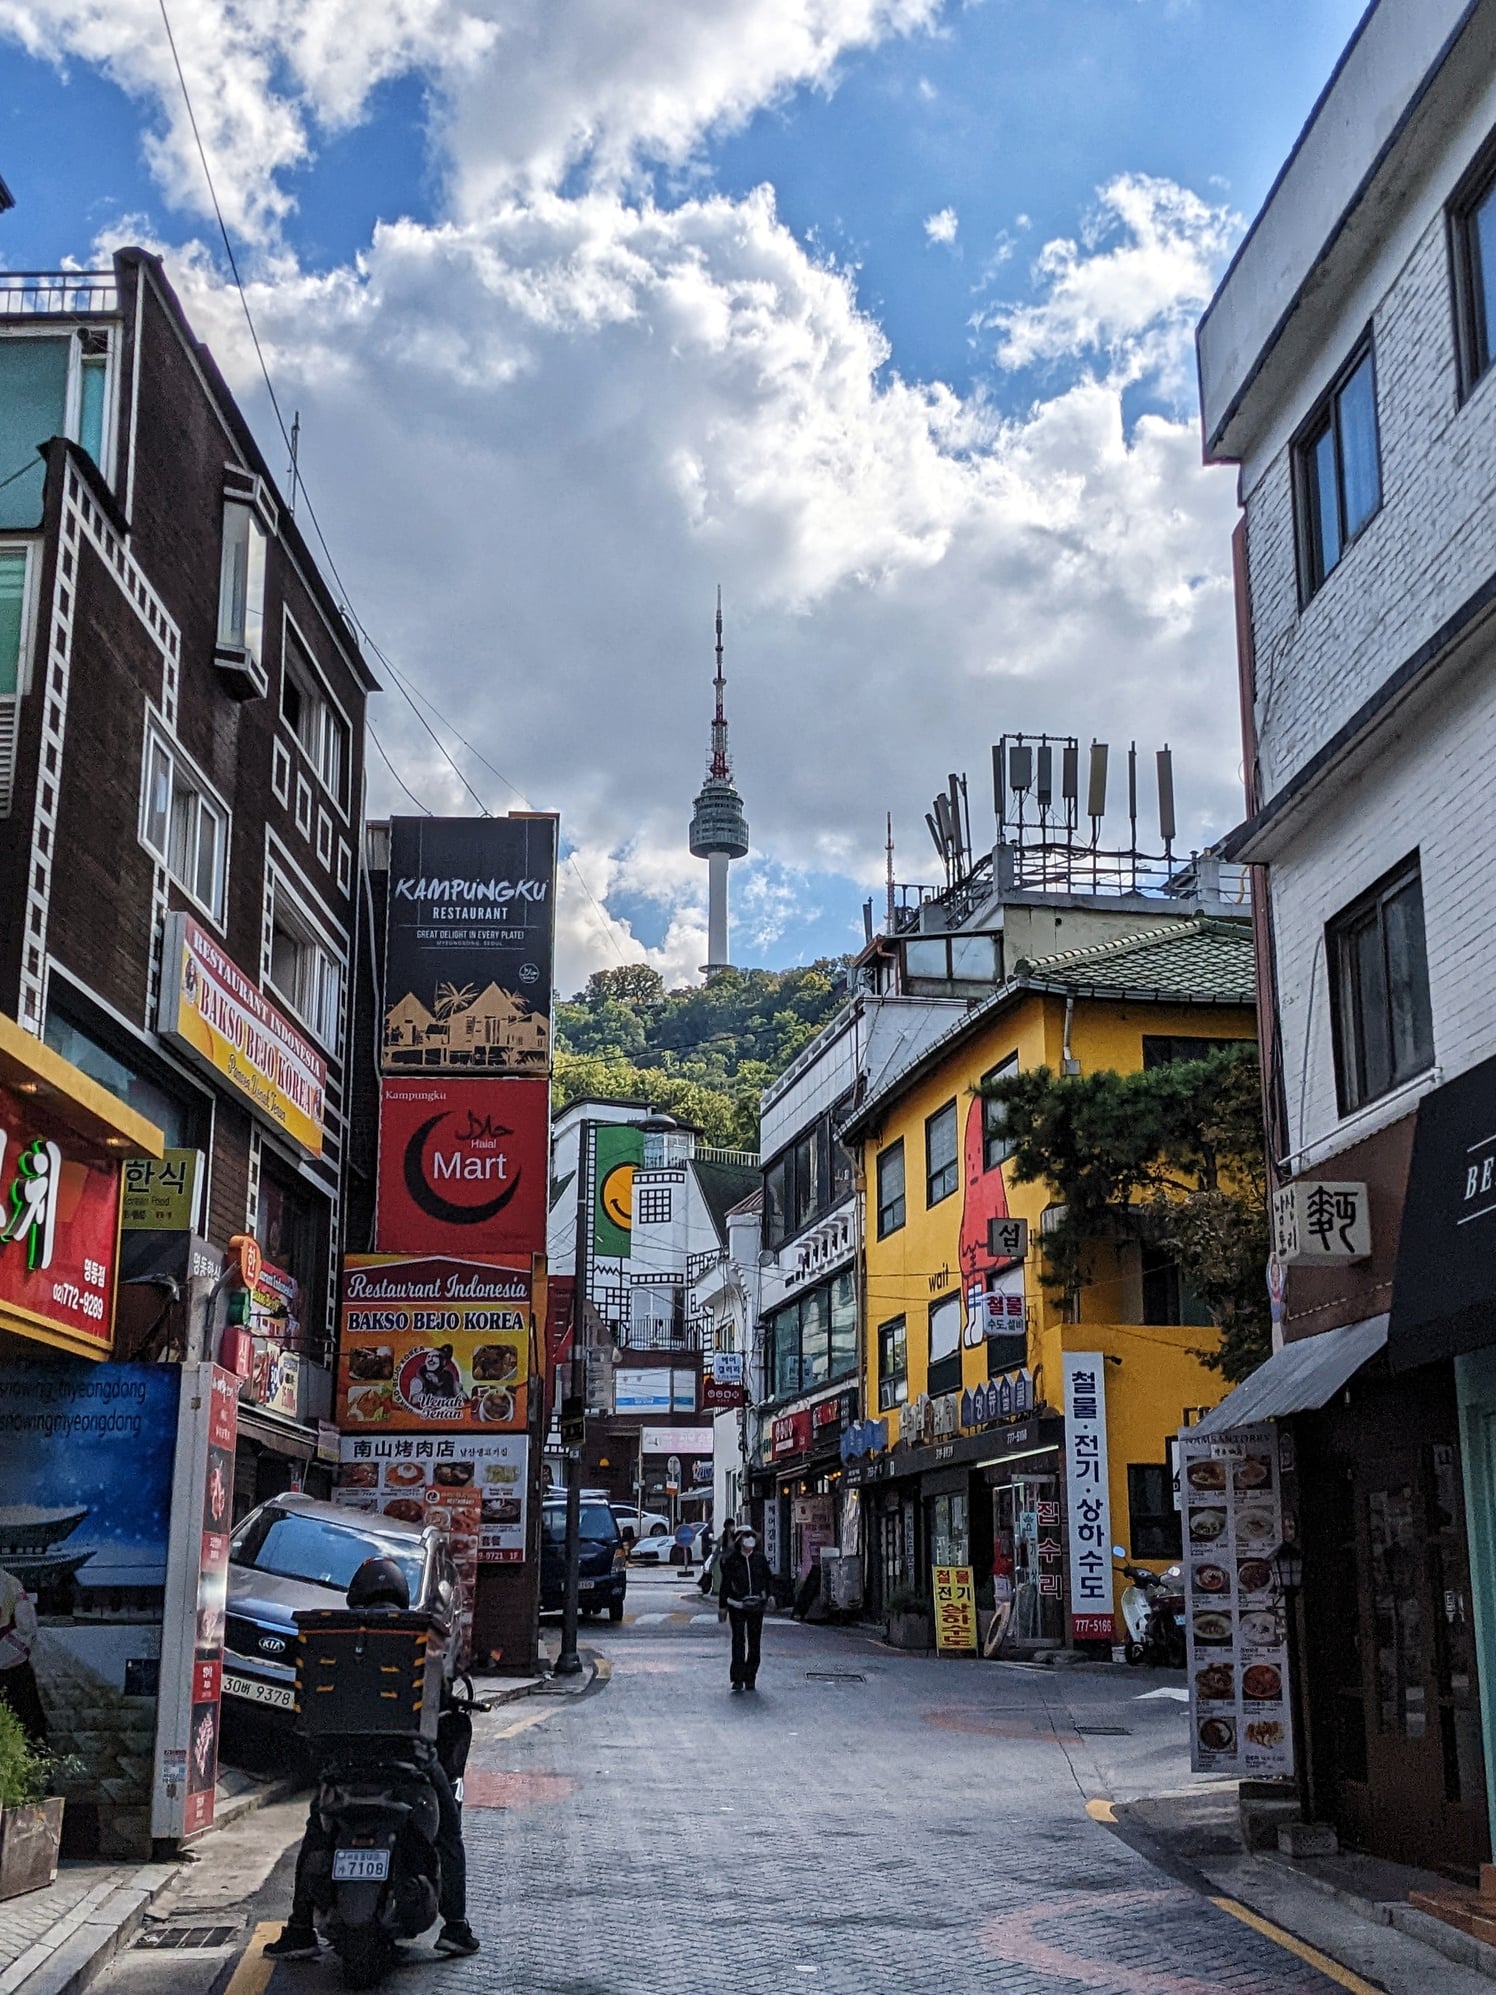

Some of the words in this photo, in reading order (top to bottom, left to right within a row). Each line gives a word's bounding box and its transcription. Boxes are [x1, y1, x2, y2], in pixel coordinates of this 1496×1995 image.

[394, 877, 549, 902] KAMPUNGKU
[433, 907, 508, 920] RESTAURANT
[417, 930, 438, 940] GREAT
[440, 930, 467, 940] DELIGHT
[469, 930, 476, 940] IN
[478, 930, 499, 940] EVERY
[501, 930, 525, 940] PLATE!
[193, 930, 269, 1022] RESTAURANT
[270, 1012, 321, 1077] INDONESIA
[199, 977, 245, 1049] BAKSO
[245, 1021, 275, 1082] BEJO
[278, 1054, 312, 1117] KOREA
[385, 1090, 447, 1101] Kampungku
[455, 1109, 514, 1140] حلال
[471, 1139, 497, 1149] Halal
[433, 1152, 507, 1180] Mart
[126, 1160, 187, 1195] 한식
[1464, 1157, 1496, 1200] BE
[84, 1258, 105, 1288] 명동점
[929, 1262, 949, 1292] wait
[348, 1273, 442, 1298] Restaurant
[445, 1273, 527, 1298] Indonesia
[987, 1296, 1022, 1316] 철물
[347, 1312, 409, 1331] BAKSO
[412, 1312, 459, 1331] BEJO
[463, 1311, 524, 1331] KOREA
[353, 1440, 455, 1459] 南山烤肉店
[1038, 1501, 1062, 1600] 집수리
[937, 1570, 969, 1584] 철물
[939, 1586, 970, 1601] 전기
[262, 1638, 281, 1650] KIA
[256, 1685, 291, 1706] 9378
[349, 1861, 383, 1876] 7108
